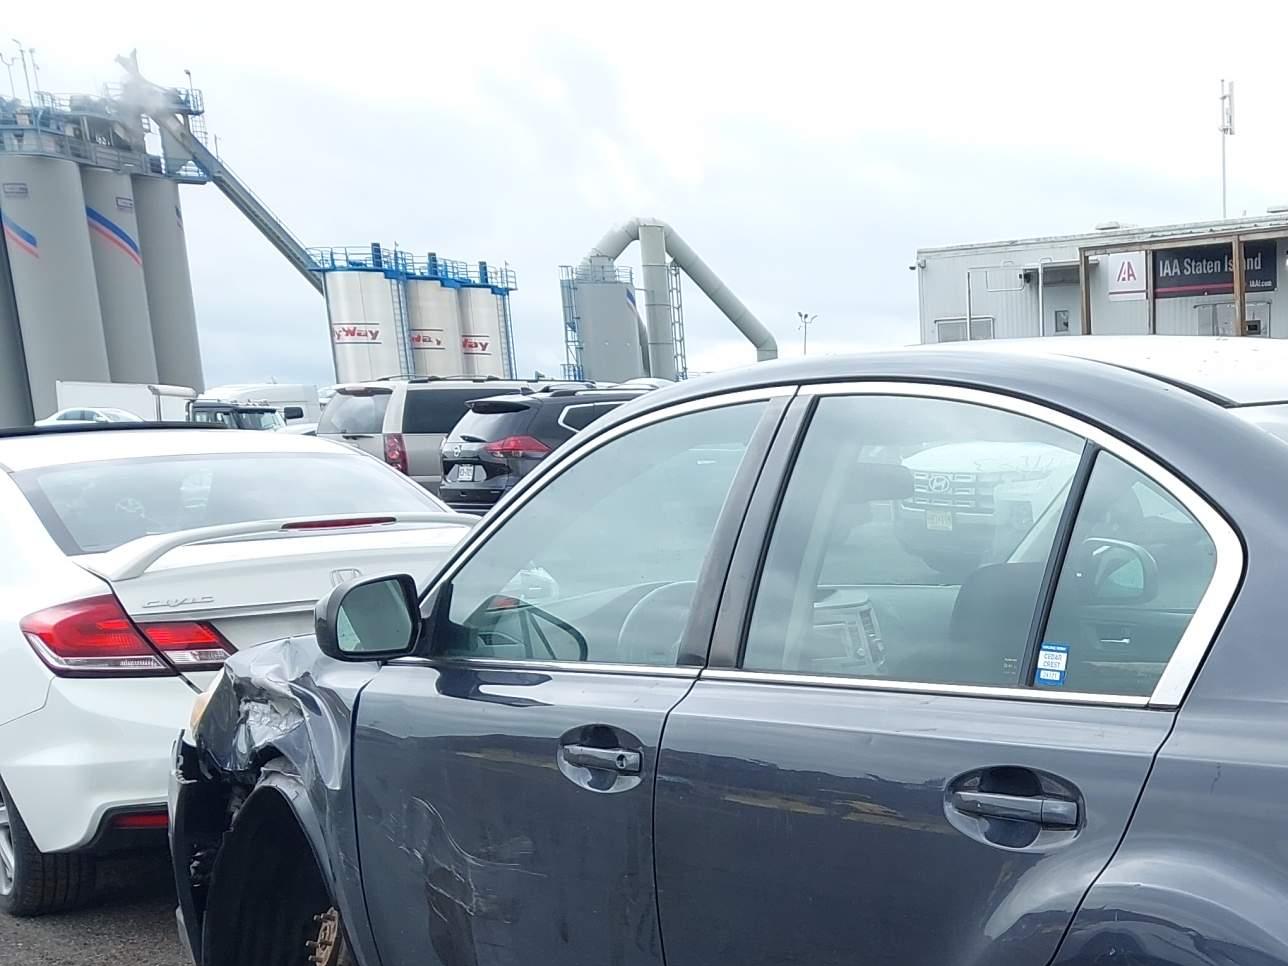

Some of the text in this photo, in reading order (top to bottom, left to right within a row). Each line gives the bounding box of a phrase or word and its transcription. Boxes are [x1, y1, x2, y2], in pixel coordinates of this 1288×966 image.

[1159, 252, 1262, 278] IAA Staten Isnd
